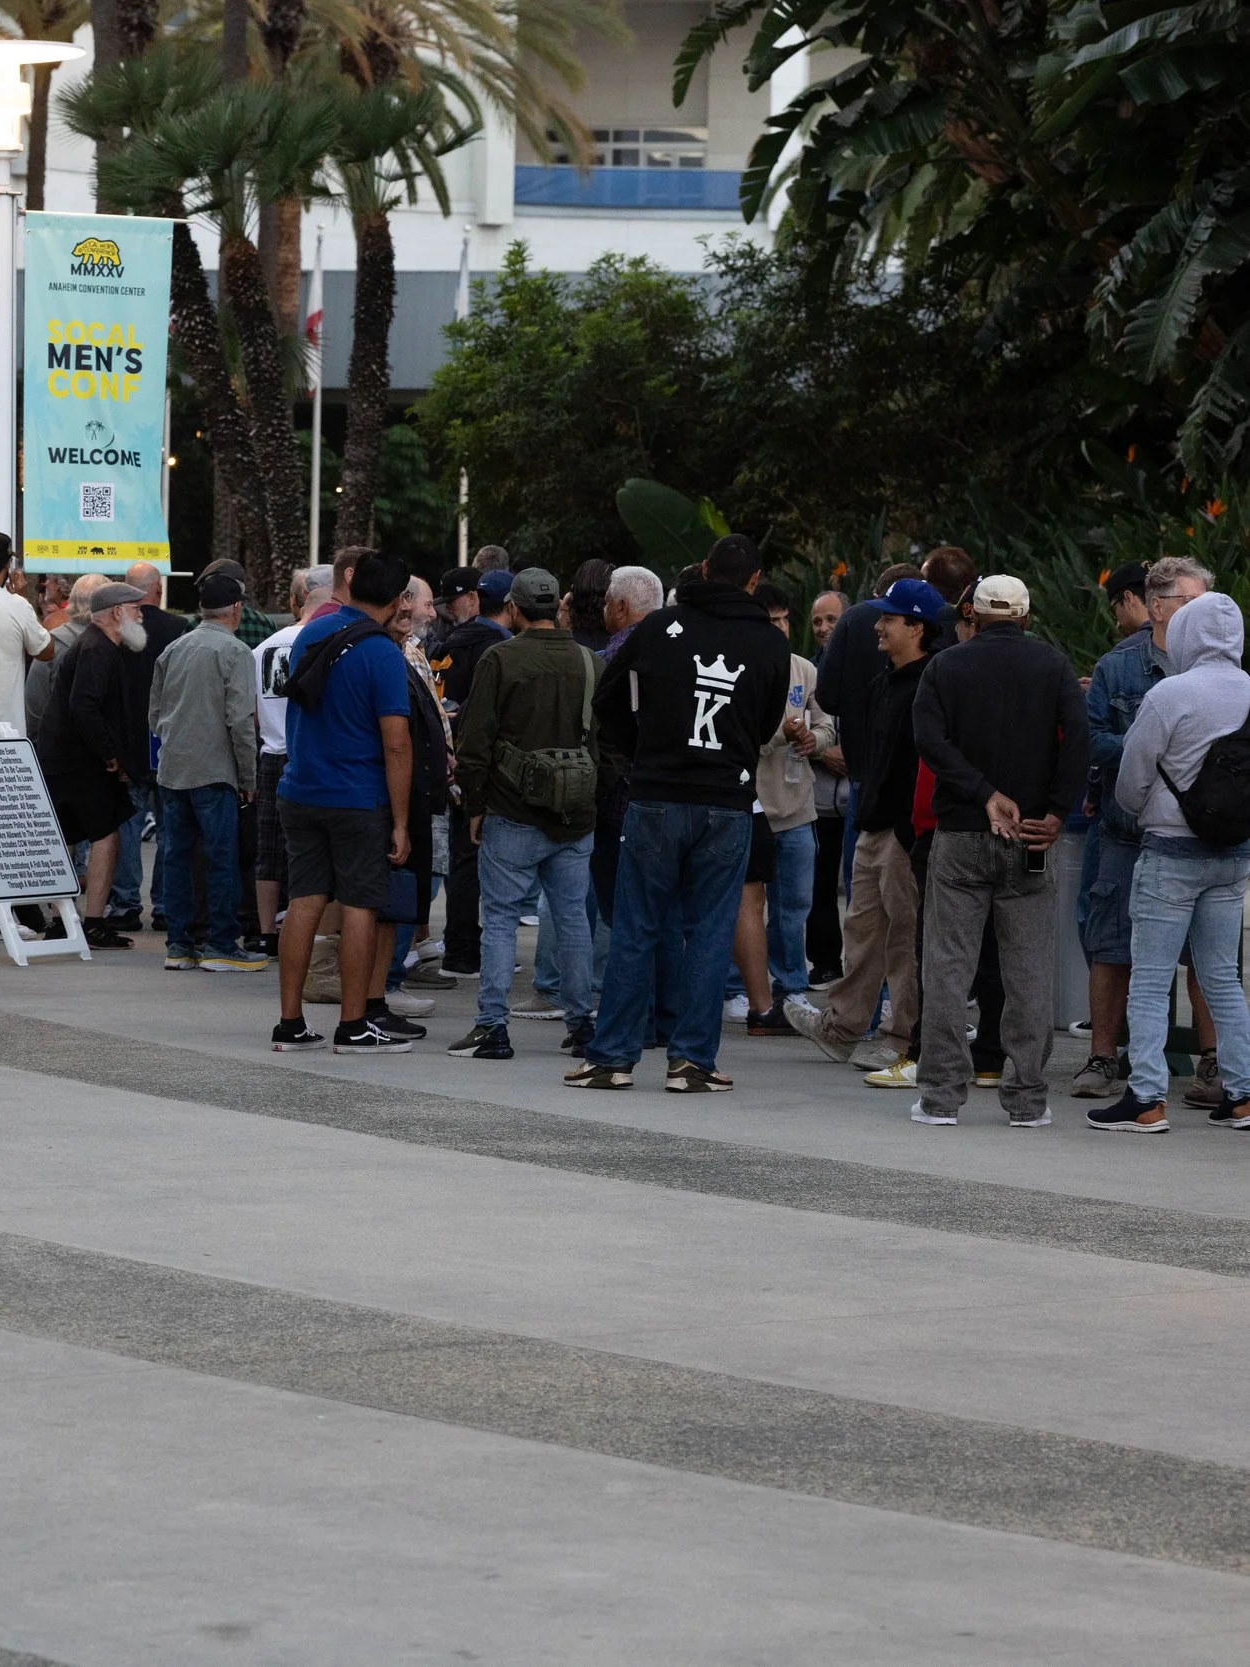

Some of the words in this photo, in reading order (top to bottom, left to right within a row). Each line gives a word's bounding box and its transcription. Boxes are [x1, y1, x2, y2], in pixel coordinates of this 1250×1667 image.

[71, 263, 125, 278] MMXXV
[48, 282, 78, 293] ANAHEIM
[78, 284, 119, 296] CONVENTION
[120, 286, 146, 297] CENTER
[47, 320, 144, 349] SOCAL
[47, 342, 143, 375] MEN'S
[47, 370, 142, 404] CONF
[48, 446, 142, 468] WELCOME
[688, 690, 731, 750] K
